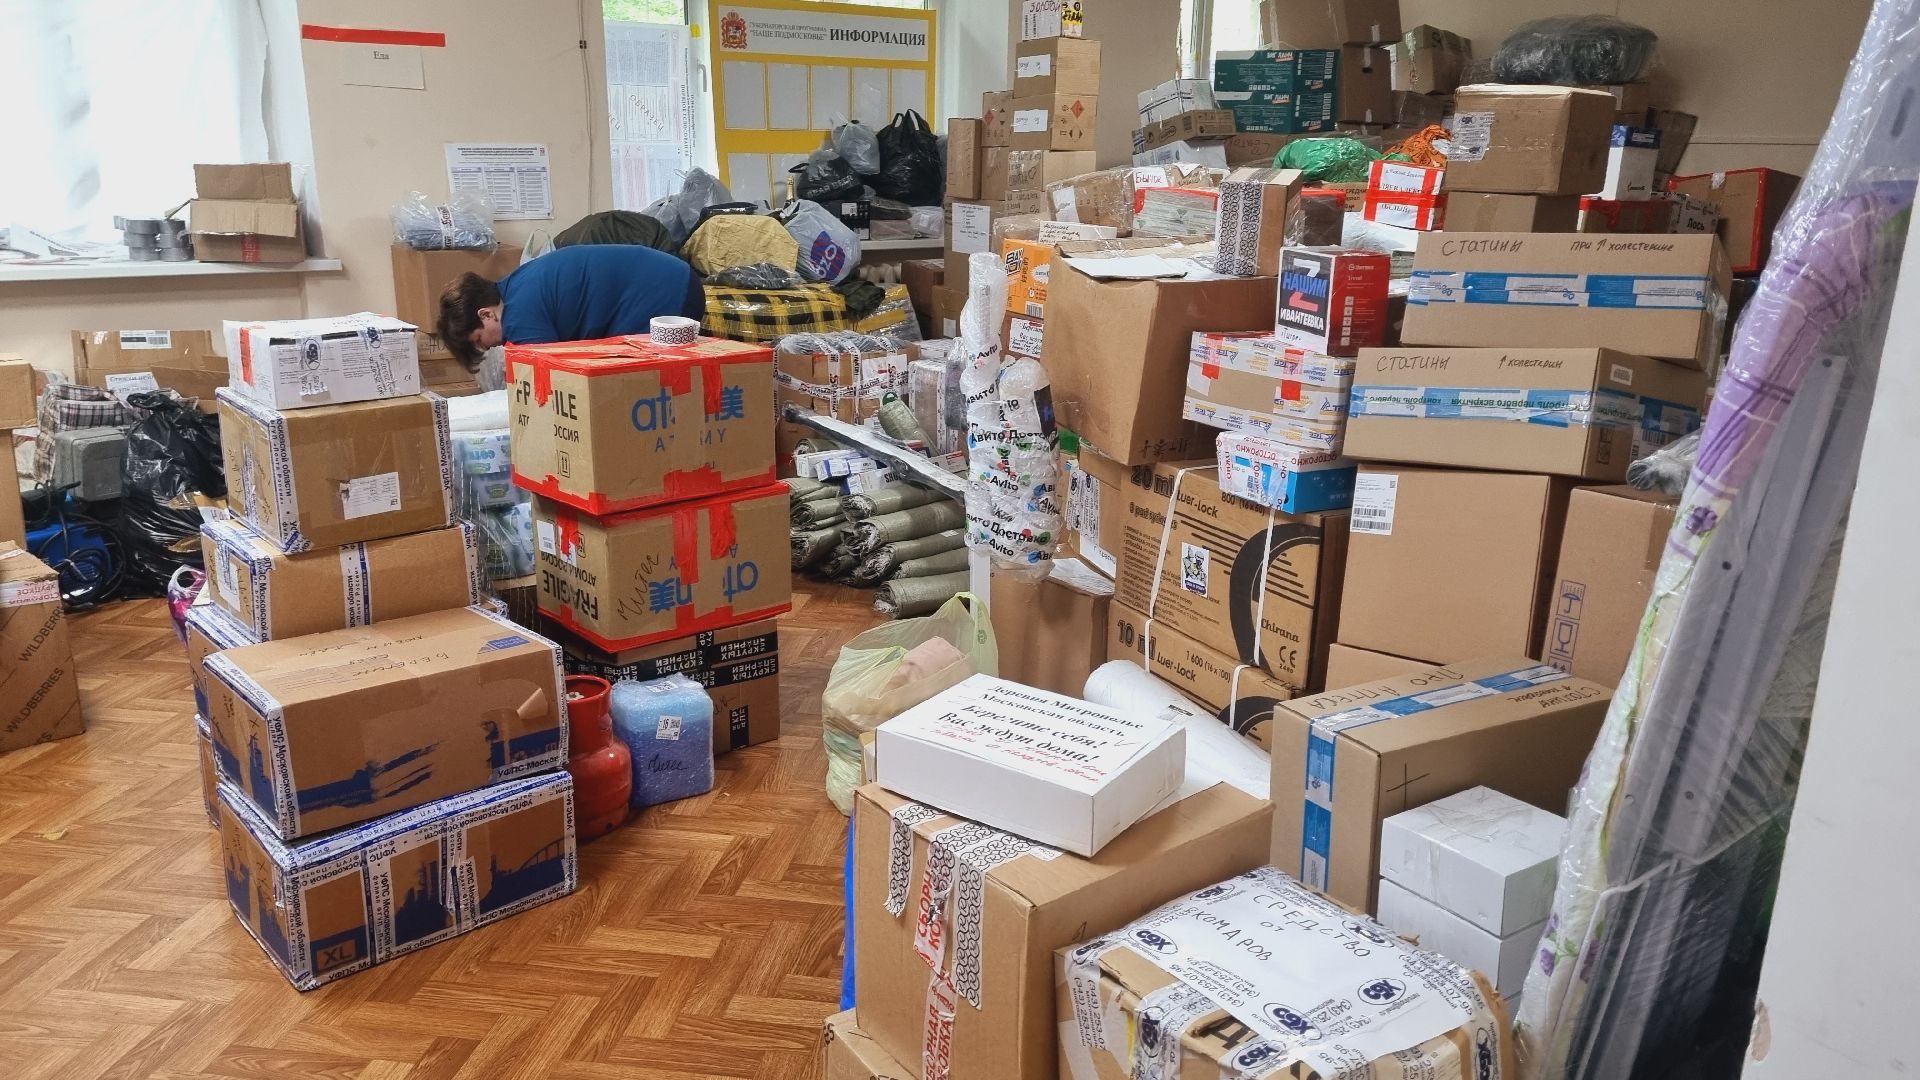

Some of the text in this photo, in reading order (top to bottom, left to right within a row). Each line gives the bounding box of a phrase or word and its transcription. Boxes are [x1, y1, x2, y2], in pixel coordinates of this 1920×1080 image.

[830, 28, 926, 48] ИНФОРМАЦИЯ
[1282, 271, 1328, 298] НАШИМ
[1280, 308, 1324, 330] ИВАНТЕЕВКА
[437, 421, 448, 469] Московской
[1236, 443, 1276, 460] ОСТОРОЖНО
[1291, 450, 1338, 465] ОСТОРОЖНО
[281, 463, 292, 498] области
[989, 474, 1019, 492] Avito
[1176, 491, 1219, 519] Luer-Lock
[1221, 491, 1235, 506] 800
[988, 538, 1015, 557] Avito
[542, 569, 599, 621] FRAGILE
[1117, 619, 1135, 648] 10
[1260, 617, 1300, 643] Chirana
[722, 645, 759, 661] КРУТЫХ
[1156, 651, 1198, 683] Luer-Lock
[1191, 651, 1204, 668] 600
[733, 667, 771, 682] КРУТЫХ
[5, 667, 65, 733] WILDBERRIES
[987, 685, 1145, 730] Деревня Митрополье
[961, 704, 1108, 750] Берегите себя!
[978, 693, 1127, 738] Московская область
[274, 716, 284, 744] УФПС
[938, 712, 970, 729] Вас
[973, 719, 1036, 745] ждут
[1036, 736, 1100, 764] дома!
[277, 744, 293, 794] Московской
[498, 765, 525, 778] УФПС
[509, 799, 534, 813] УФПС
[369, 847, 397, 863] УФПС
[289, 876, 304, 927] Московской
[381, 872, 394, 945] УФПС Московской
[473, 910, 498, 925] УФПС
[499, 893, 547, 915] Московской
[917, 870, 933, 938] СБОРН
[1193, 910, 1274, 961] КОМАРОВ
[1253, 894, 1371, 958] СРЕДСТВО
[295, 927, 305, 962] области
[414, 931, 449, 950] области
[323, 946, 352, 967] XL
[328, 965, 356, 981] УФПС
